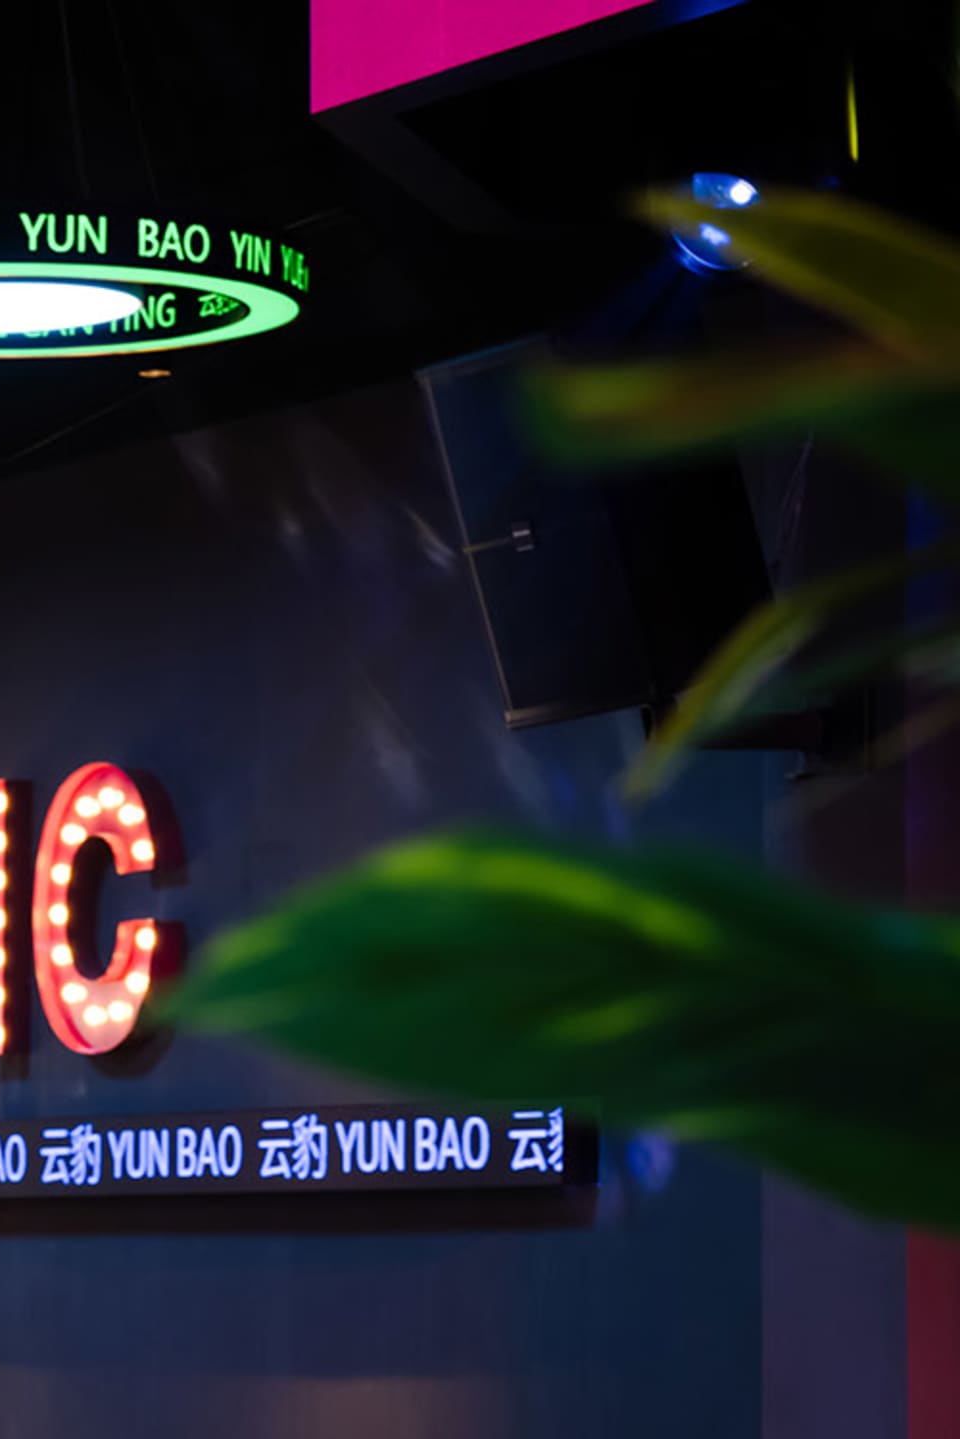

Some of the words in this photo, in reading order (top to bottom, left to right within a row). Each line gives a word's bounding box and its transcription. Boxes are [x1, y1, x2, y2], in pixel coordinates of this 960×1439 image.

[19, 212, 108, 254] YUN
[137, 218, 211, 264] BAO
[229, 230, 272, 276] YIN
[39, 1123, 103, 1186] 云豹
[106, 1128, 170, 1180] YUN
[176, 1124, 242, 1179] BAO
[257, 1113, 328, 1180] 云豹
[334, 1118, 406, 1174] YUN
[414, 1116, 490, 1172] BAO
